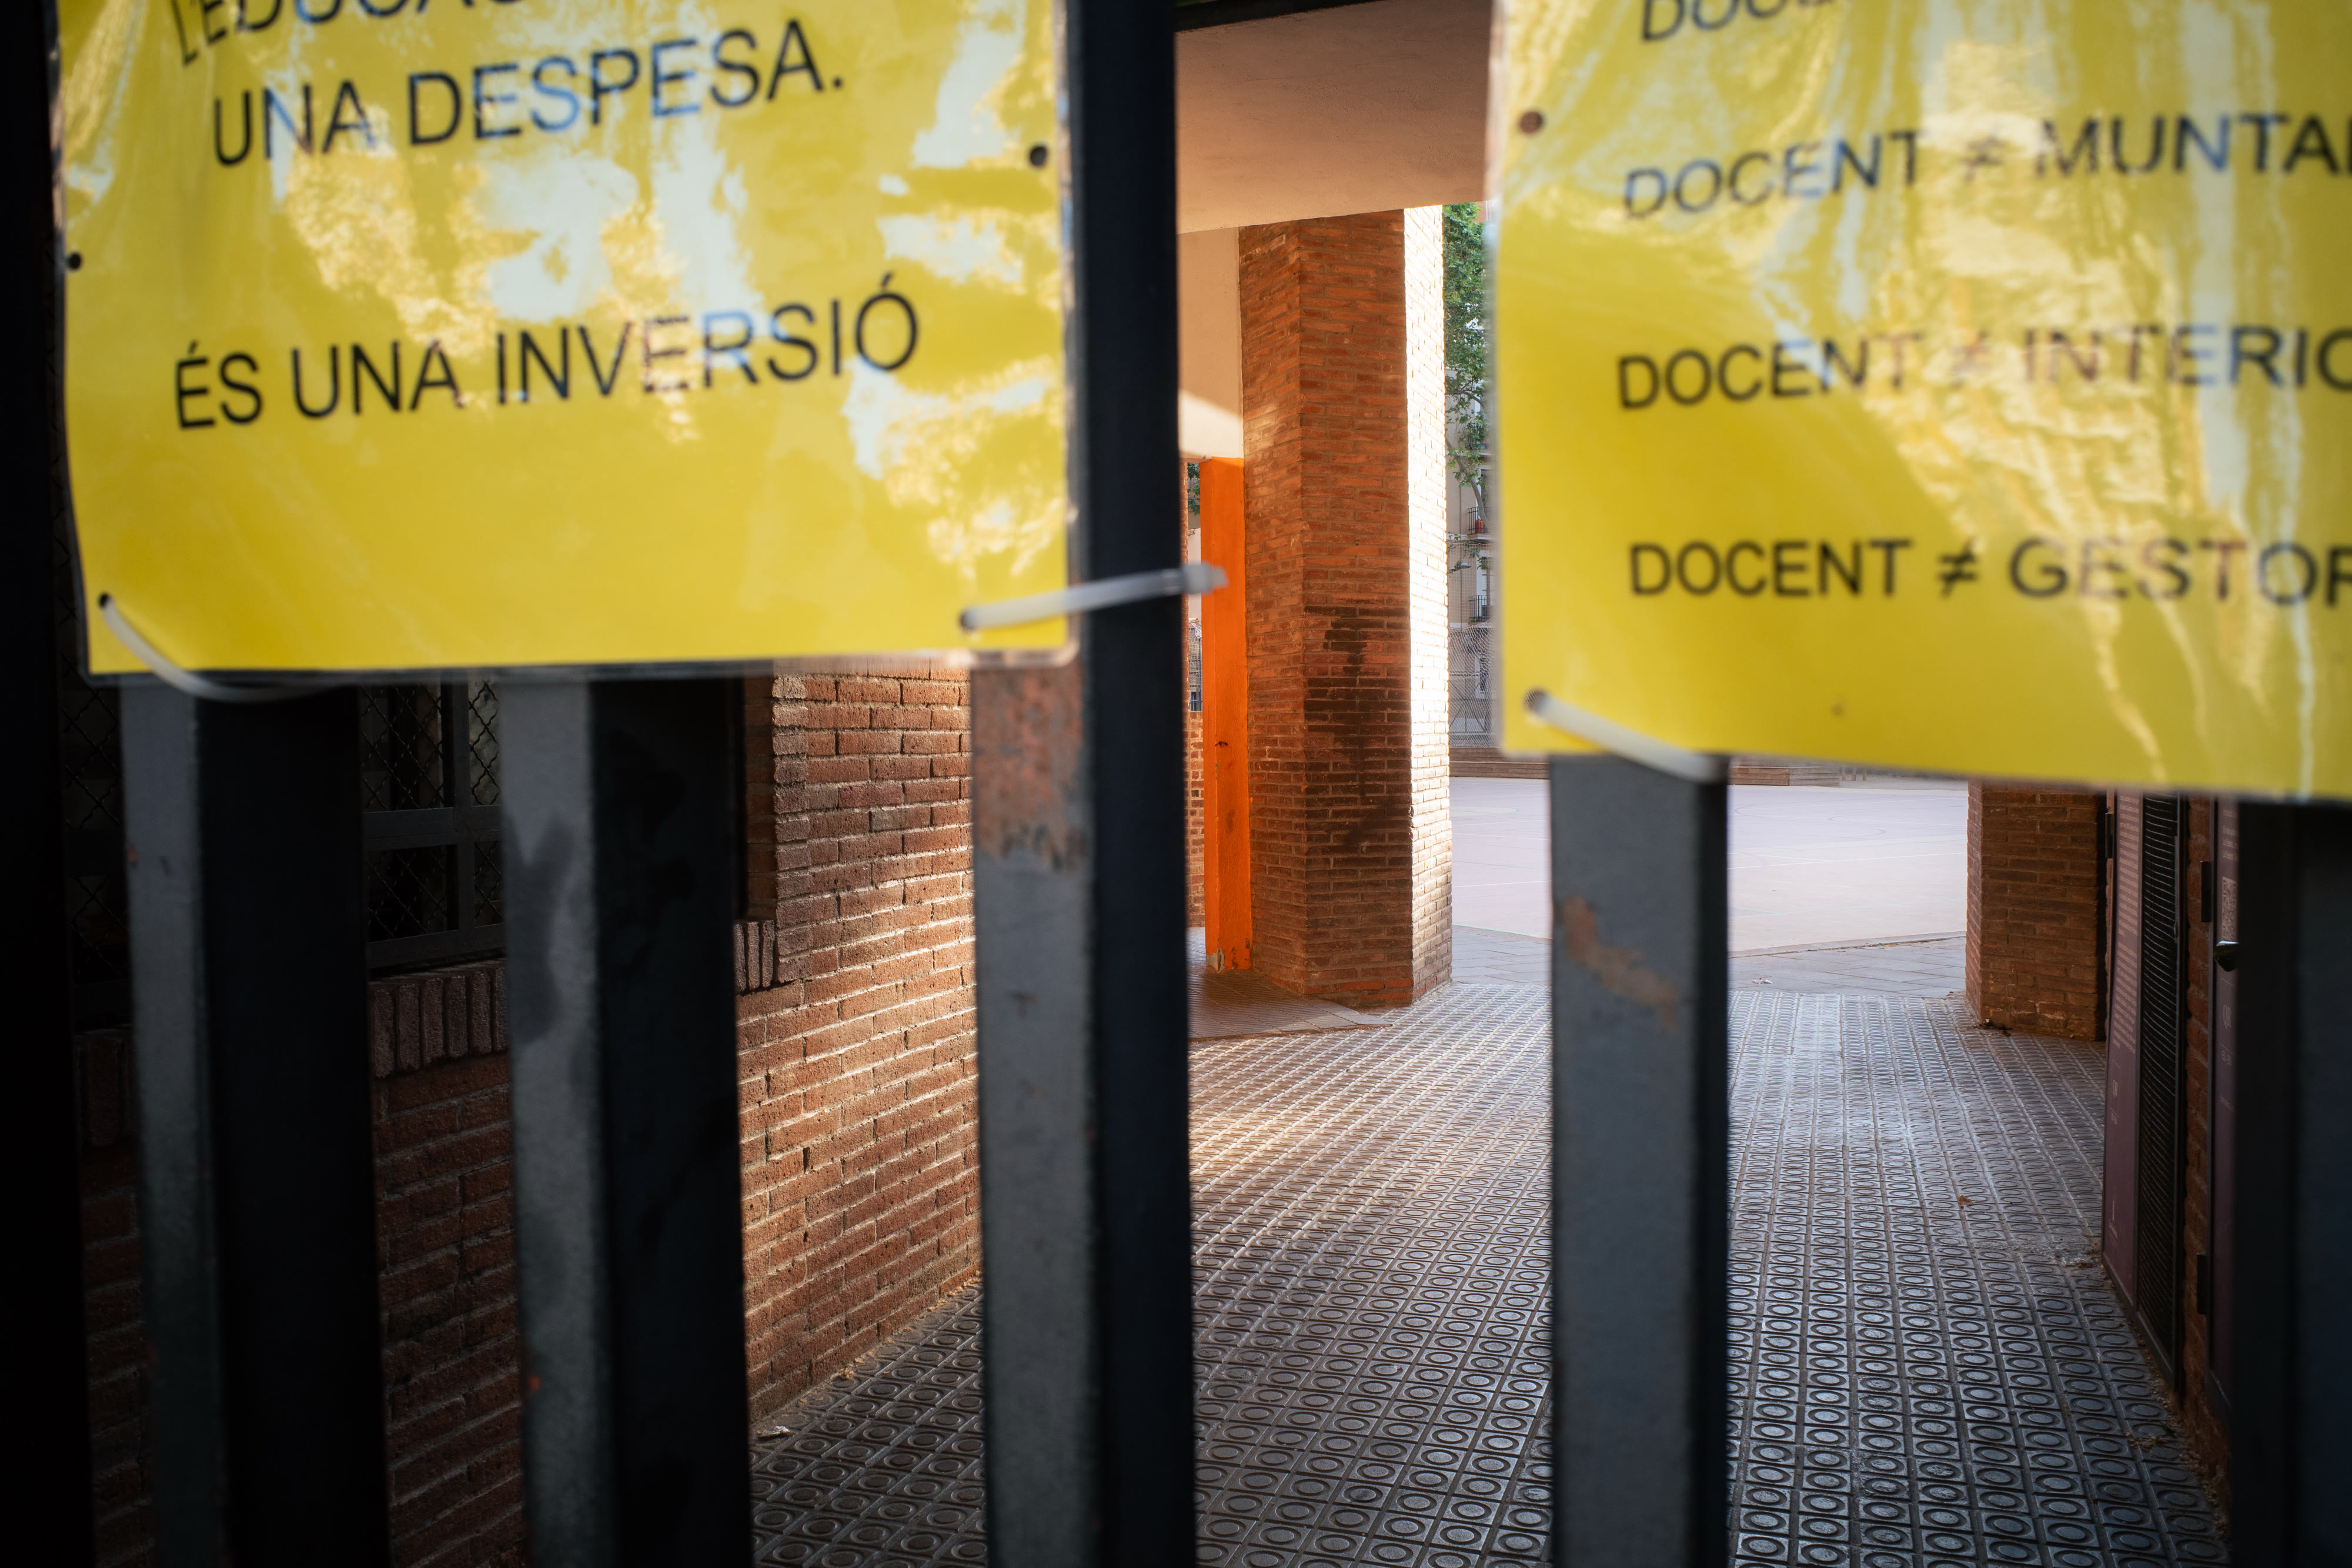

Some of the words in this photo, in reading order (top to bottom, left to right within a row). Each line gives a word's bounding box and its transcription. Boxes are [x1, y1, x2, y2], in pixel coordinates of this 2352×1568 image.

[215, 80, 377, 167] UNA
[408, 19, 843, 146] DESPESA.
[1623, 129, 1920, 219] DOCENT
[2034, 113, 2352, 176] MUNTA
[175, 340, 262, 430] ÉS
[292, 340, 465, 418] UNA
[497, 272, 918, 406] INVERSIÓ
[1618, 331, 1923, 410] DOCENT
[1629, 536, 1913, 597] DOCENT
